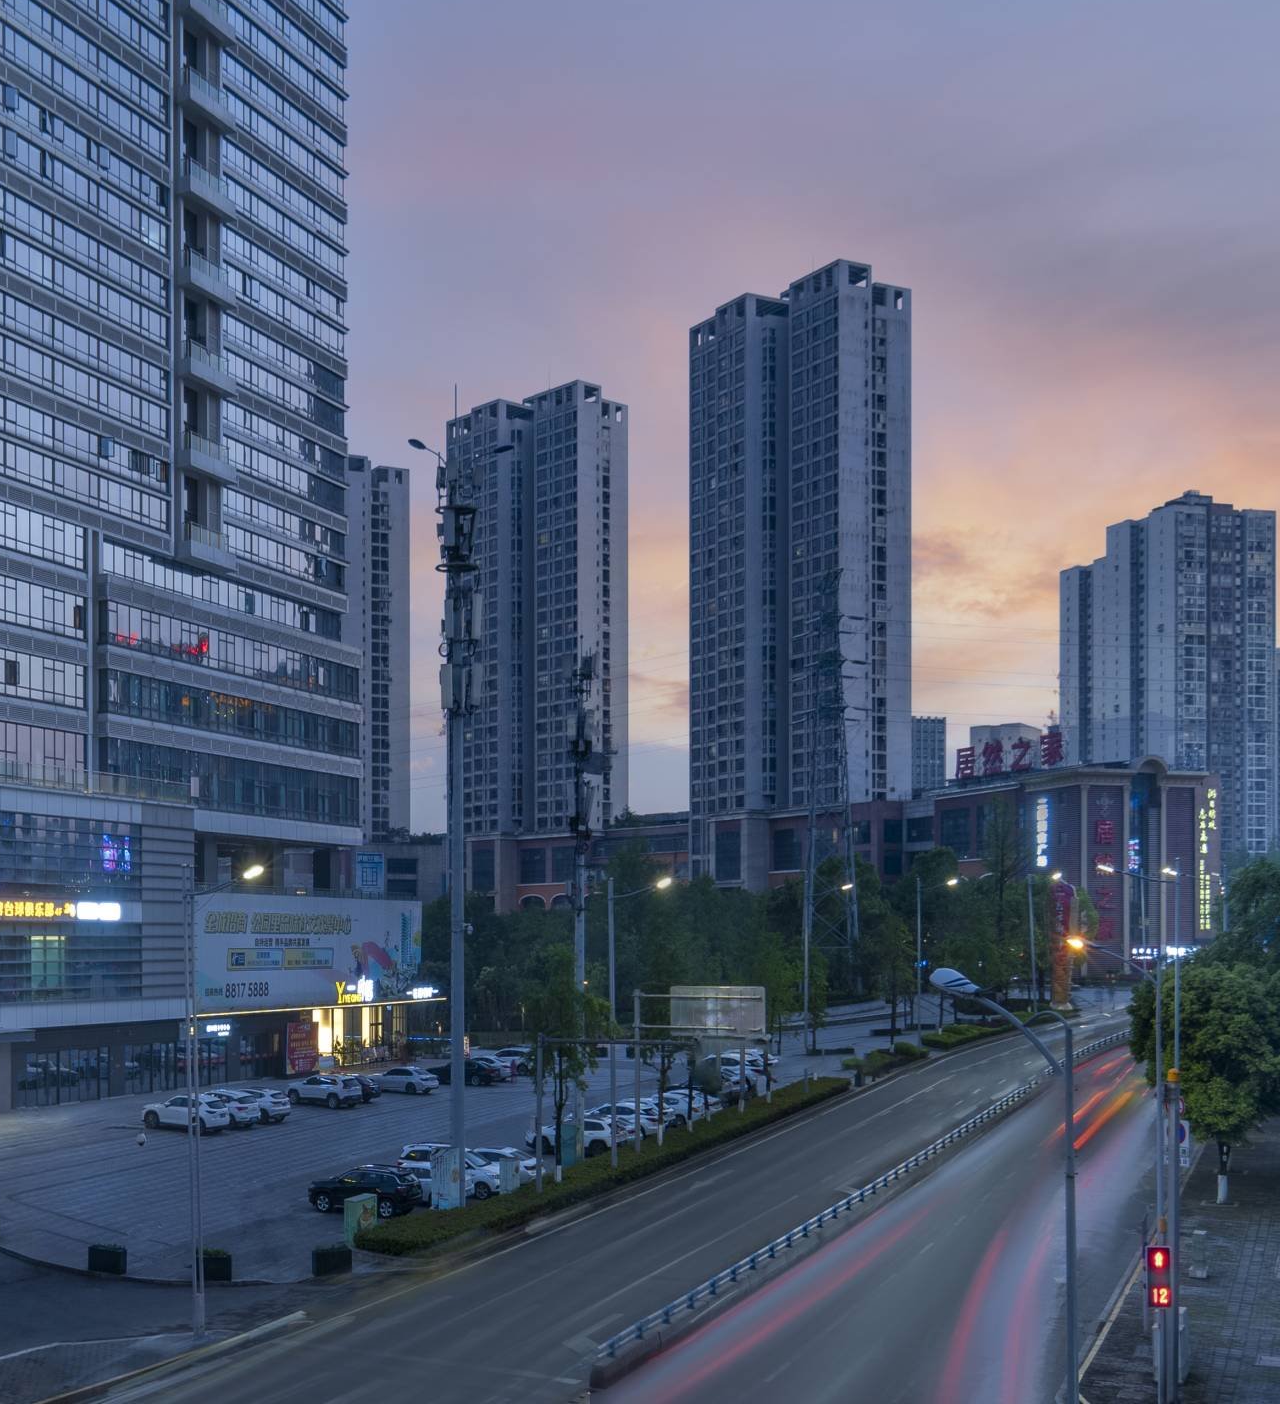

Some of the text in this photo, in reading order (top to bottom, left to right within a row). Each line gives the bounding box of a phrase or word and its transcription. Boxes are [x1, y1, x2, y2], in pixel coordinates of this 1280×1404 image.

[956, 732, 1064, 778] 居然之家
[225, 983, 246, 998] 8817
[247, 981, 269, 997] 5888
[1153, 1288, 1168, 1304] 12
